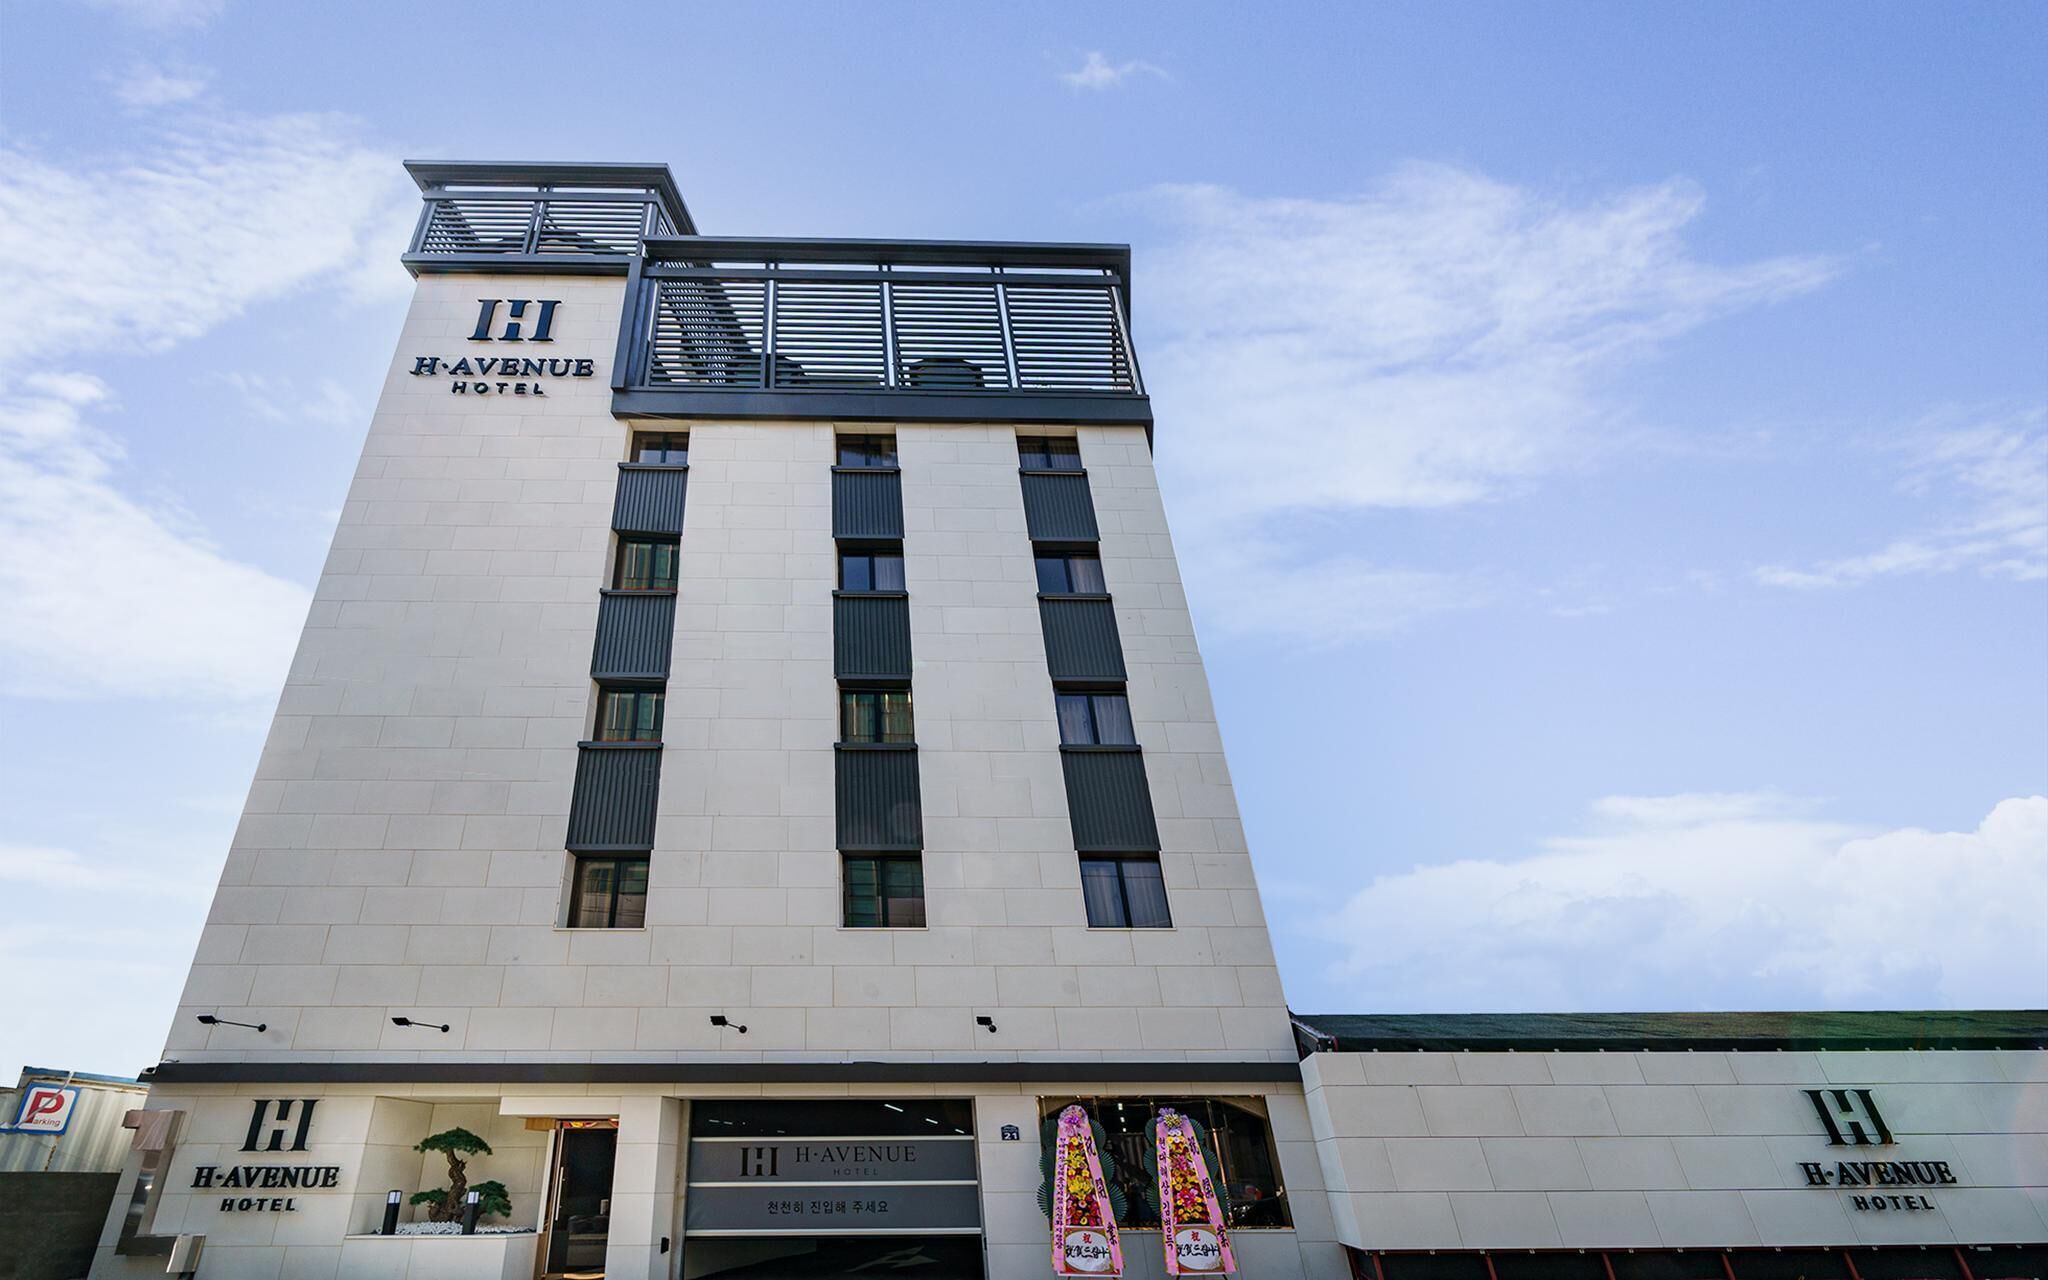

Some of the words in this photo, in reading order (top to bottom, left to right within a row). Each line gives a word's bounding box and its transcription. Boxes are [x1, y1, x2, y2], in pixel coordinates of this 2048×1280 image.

[451, 381, 544, 395] HOTEL
[1004, 1132, 1018, 1140] 21
[833, 1168, 879, 1176] HOTEL
[219, 1197, 297, 1212] HOTEL
[767, 1200, 804, 1215] 천천히
[809, 1200, 847, 1215] 진입해
[852, 1200, 889, 1214] 주세요
[1850, 1194, 1936, 1211] HOTEL
